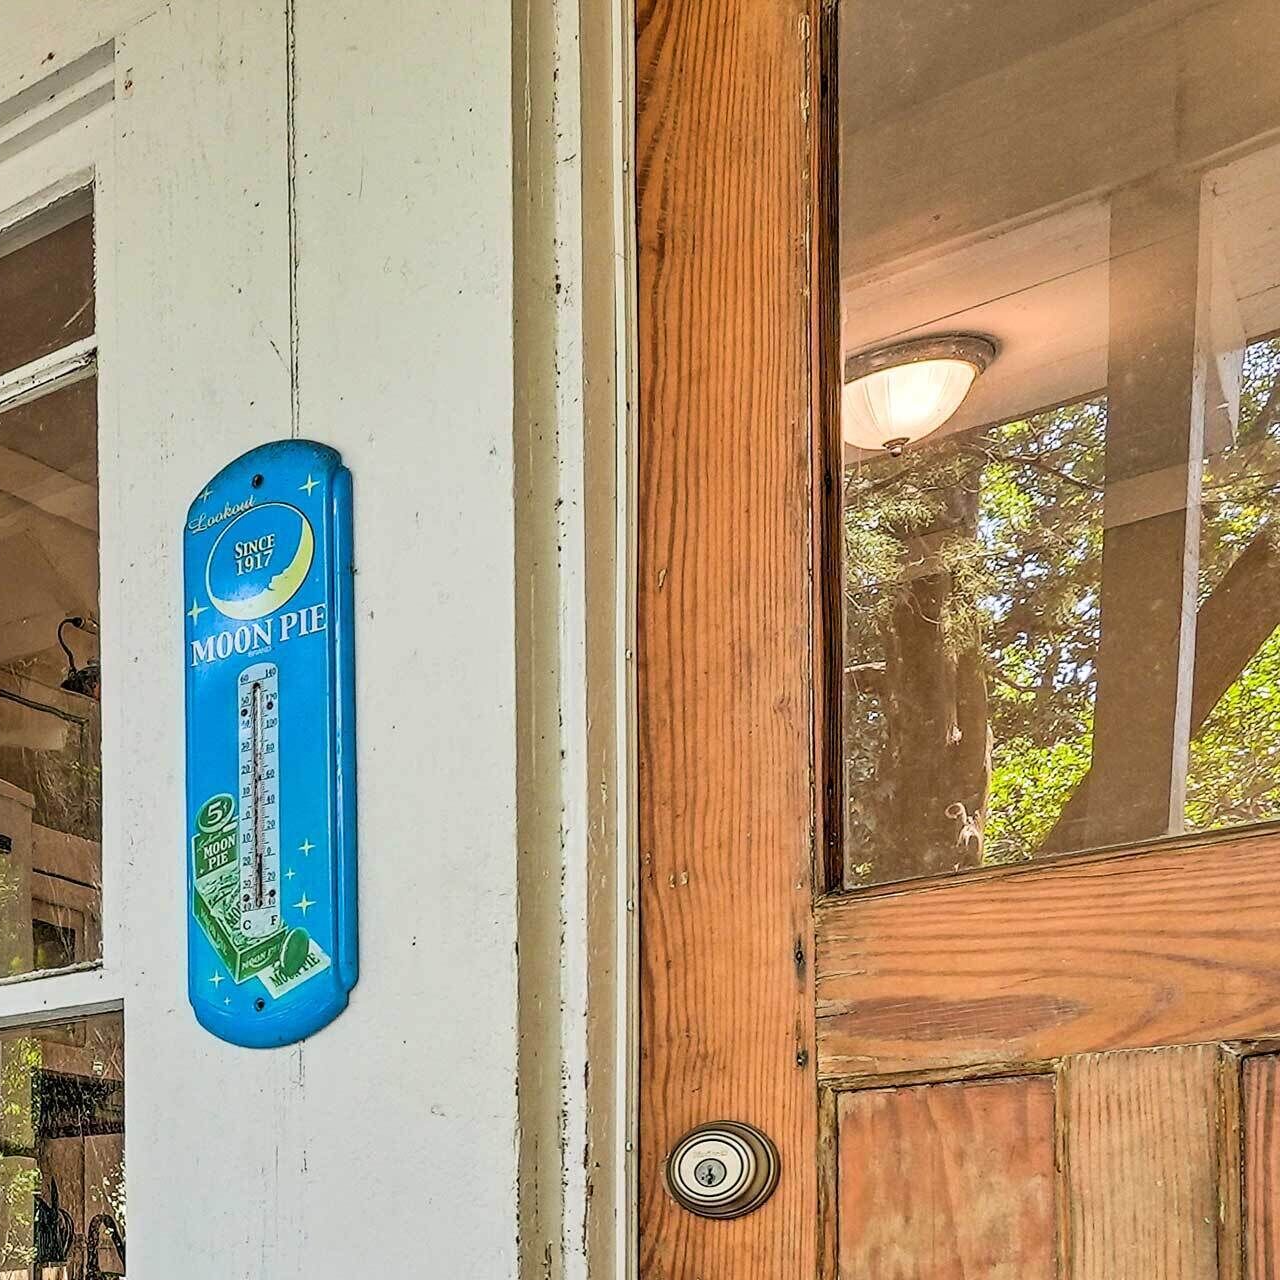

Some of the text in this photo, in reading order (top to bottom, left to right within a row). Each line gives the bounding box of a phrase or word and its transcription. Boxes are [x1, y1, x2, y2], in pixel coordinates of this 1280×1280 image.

[188, 494, 256, 534] Lookout
[235, 533, 276, 559] SINCE
[236, 549, 273, 576] 1917
[191, 603, 327, 667] MOON PIE
[240, 674, 249, 683] 60
[241, 765, 251, 774] 20
[242, 786, 251, 796] 10
[203, 833, 236, 859] MOON
[242, 833, 252, 843] 10
[208, 850, 229, 870] PIE
[243, 920, 251, 930] C
[271, 914, 278, 925] F
[269, 967, 302, 988] MO
